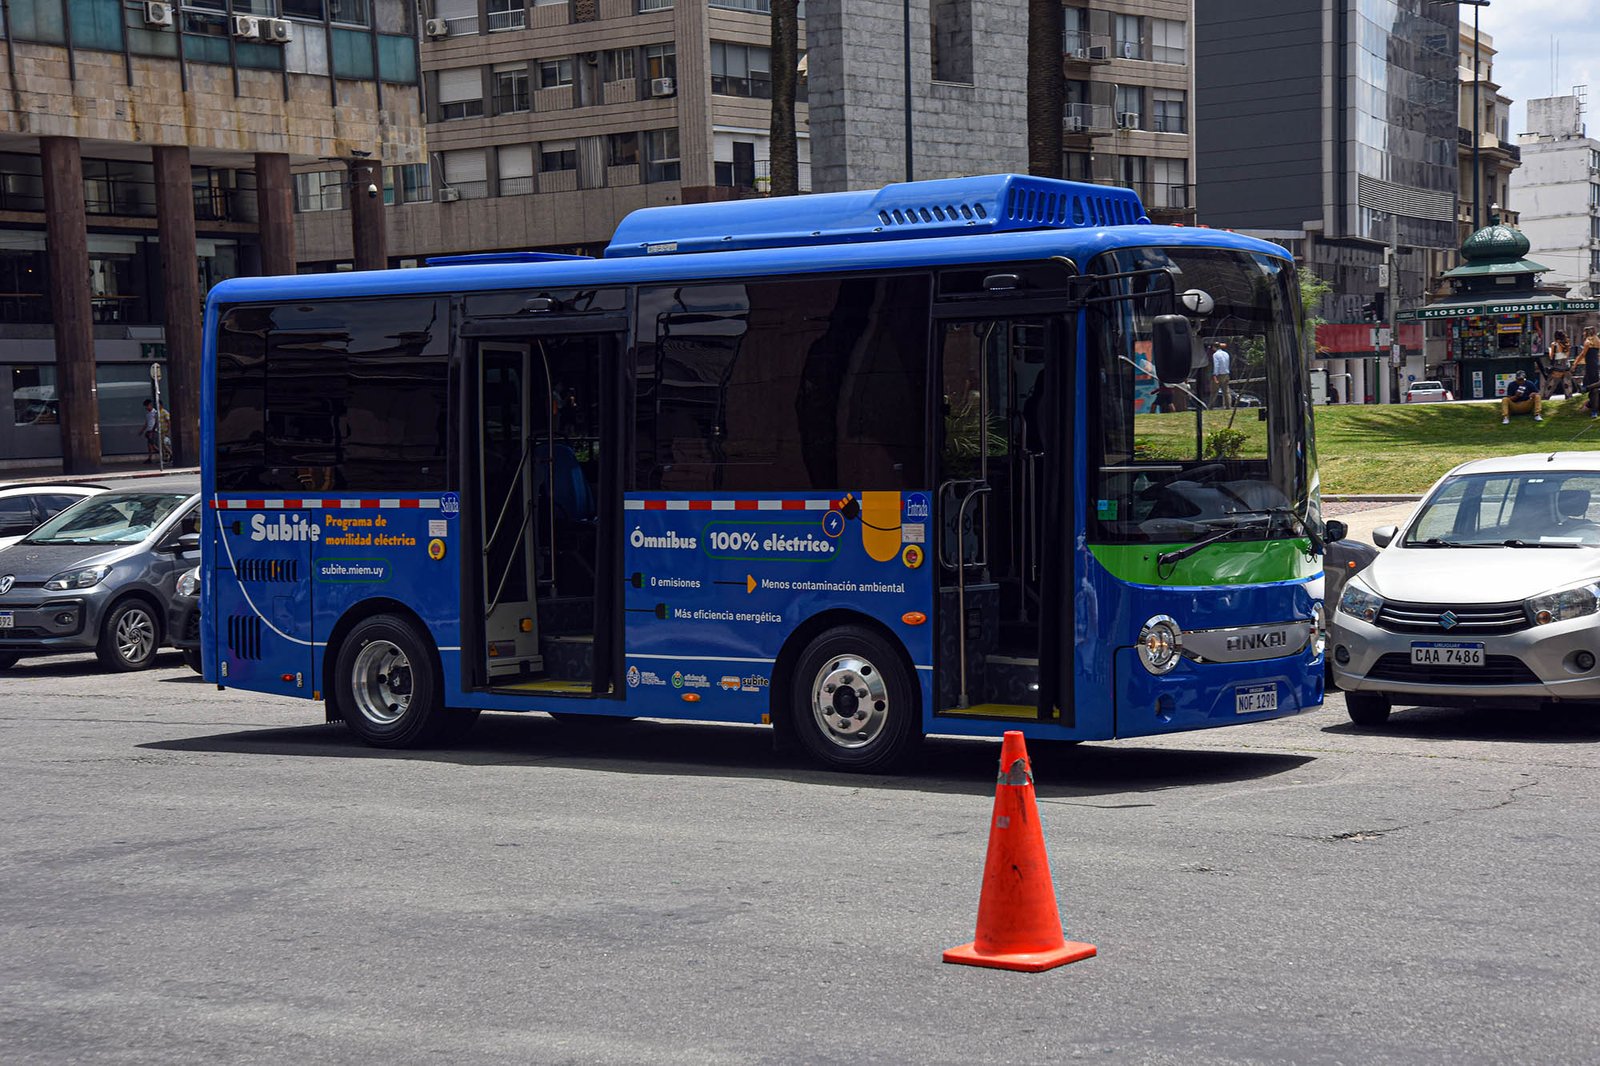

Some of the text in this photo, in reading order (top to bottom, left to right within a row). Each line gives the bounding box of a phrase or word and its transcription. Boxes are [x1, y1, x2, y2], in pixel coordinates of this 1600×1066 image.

[1425, 308, 1475, 317] KIOSCO
[1492, 303, 1553, 313] CIUDADELA
[441, 496, 459, 513] Salida
[907, 499, 929, 517] Entrada
[251, 513, 321, 542] Subite
[325, 514, 387, 531] Programa de
[325, 532, 416, 546] movilidad eléctrica
[630, 525, 835, 553] Ómnibus 100% eléctrico.
[321, 563, 384, 578] subite.miem.uy
[650, 576, 701, 588] 0 emisiones
[761, 579, 905, 593] Menos contaminación ambiental
[674, 607, 782, 624] Más eficiencia energética
[1227, 631, 1286, 651] ANKAI
[1415, 649, 1479, 663] CAA 7486
[742, 675, 769, 686] subite
[1238, 695, 1253, 711] NOF
